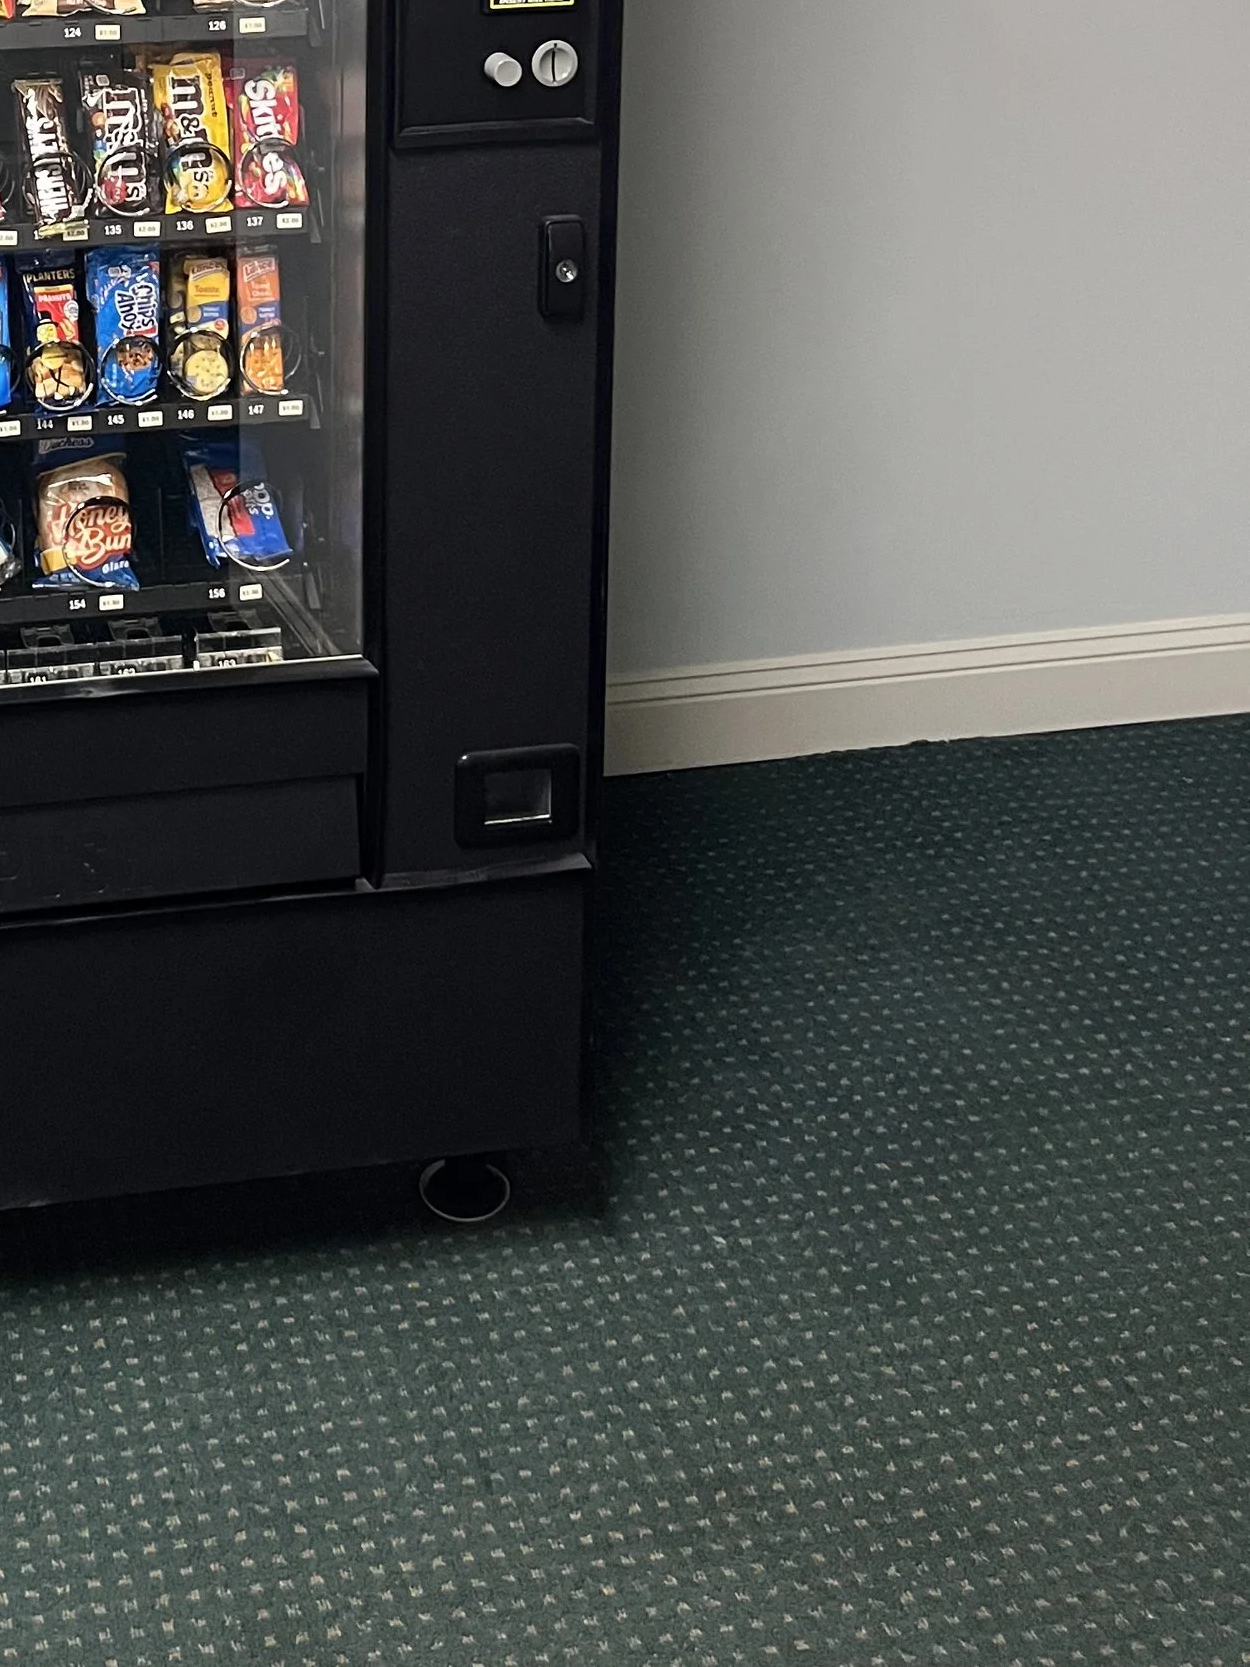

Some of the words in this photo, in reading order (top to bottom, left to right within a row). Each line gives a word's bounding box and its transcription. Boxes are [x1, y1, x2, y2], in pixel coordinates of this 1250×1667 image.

[208, 20, 226, 31] 126
[64, 27, 81, 38] 124
[176, 221, 194, 231] 136
[246, 216, 264, 227] 137
[104, 225, 122, 236] 135
[27, 268, 76, 283] PLANTERS
[38, 294, 72, 303] PEANUTS
[131, 283, 156, 328] Chips
[177, 409, 195, 420] 146
[248, 404, 265, 415] 147
[36, 418, 54, 430] 144
[107, 414, 125, 426] 145
[79, 527, 132, 565] Bun
[208, 587, 226, 599] 156
[69, 599, 86, 610] 154
